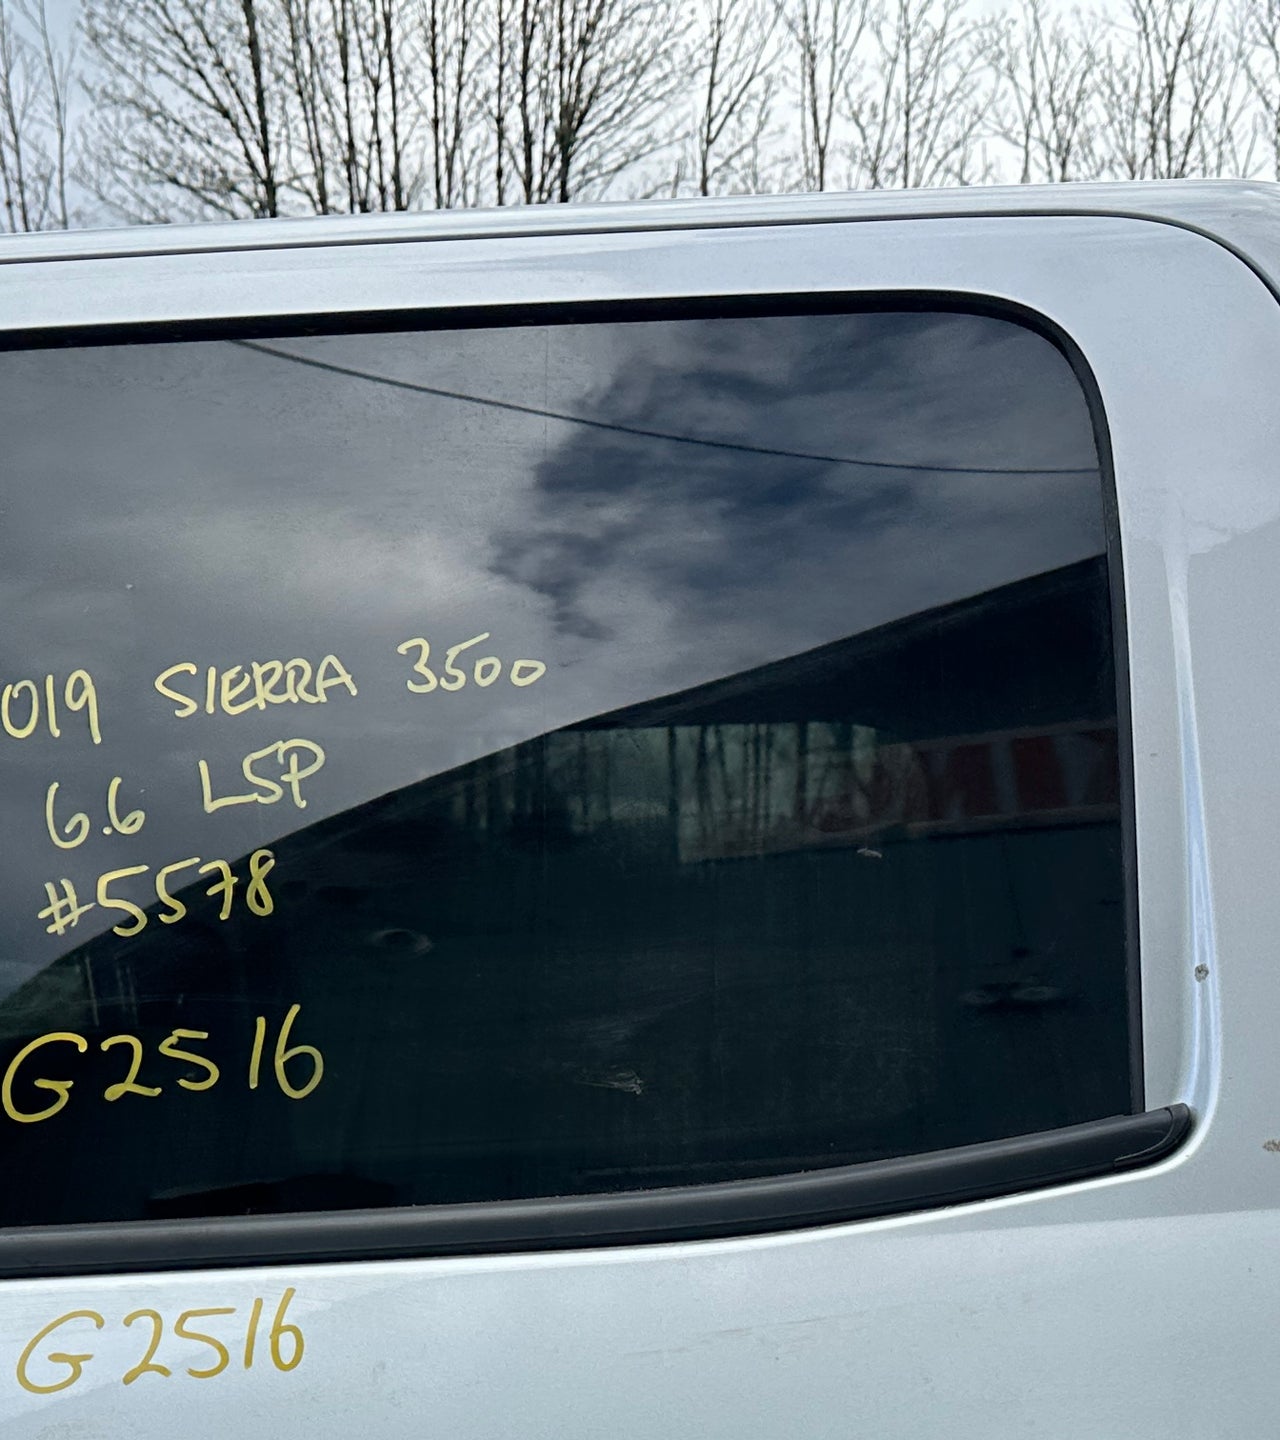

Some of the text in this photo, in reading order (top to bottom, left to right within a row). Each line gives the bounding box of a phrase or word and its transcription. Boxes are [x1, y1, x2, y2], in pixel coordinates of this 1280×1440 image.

[154, 654, 358, 718] SIERRA
[397, 632, 547, 693] 3500
[45, 776, 146, 849] 6.6
[37, 848, 276, 937] #5578
[1, 1004, 324, 1124] G2516
[16, 1286, 305, 1395] G2516
